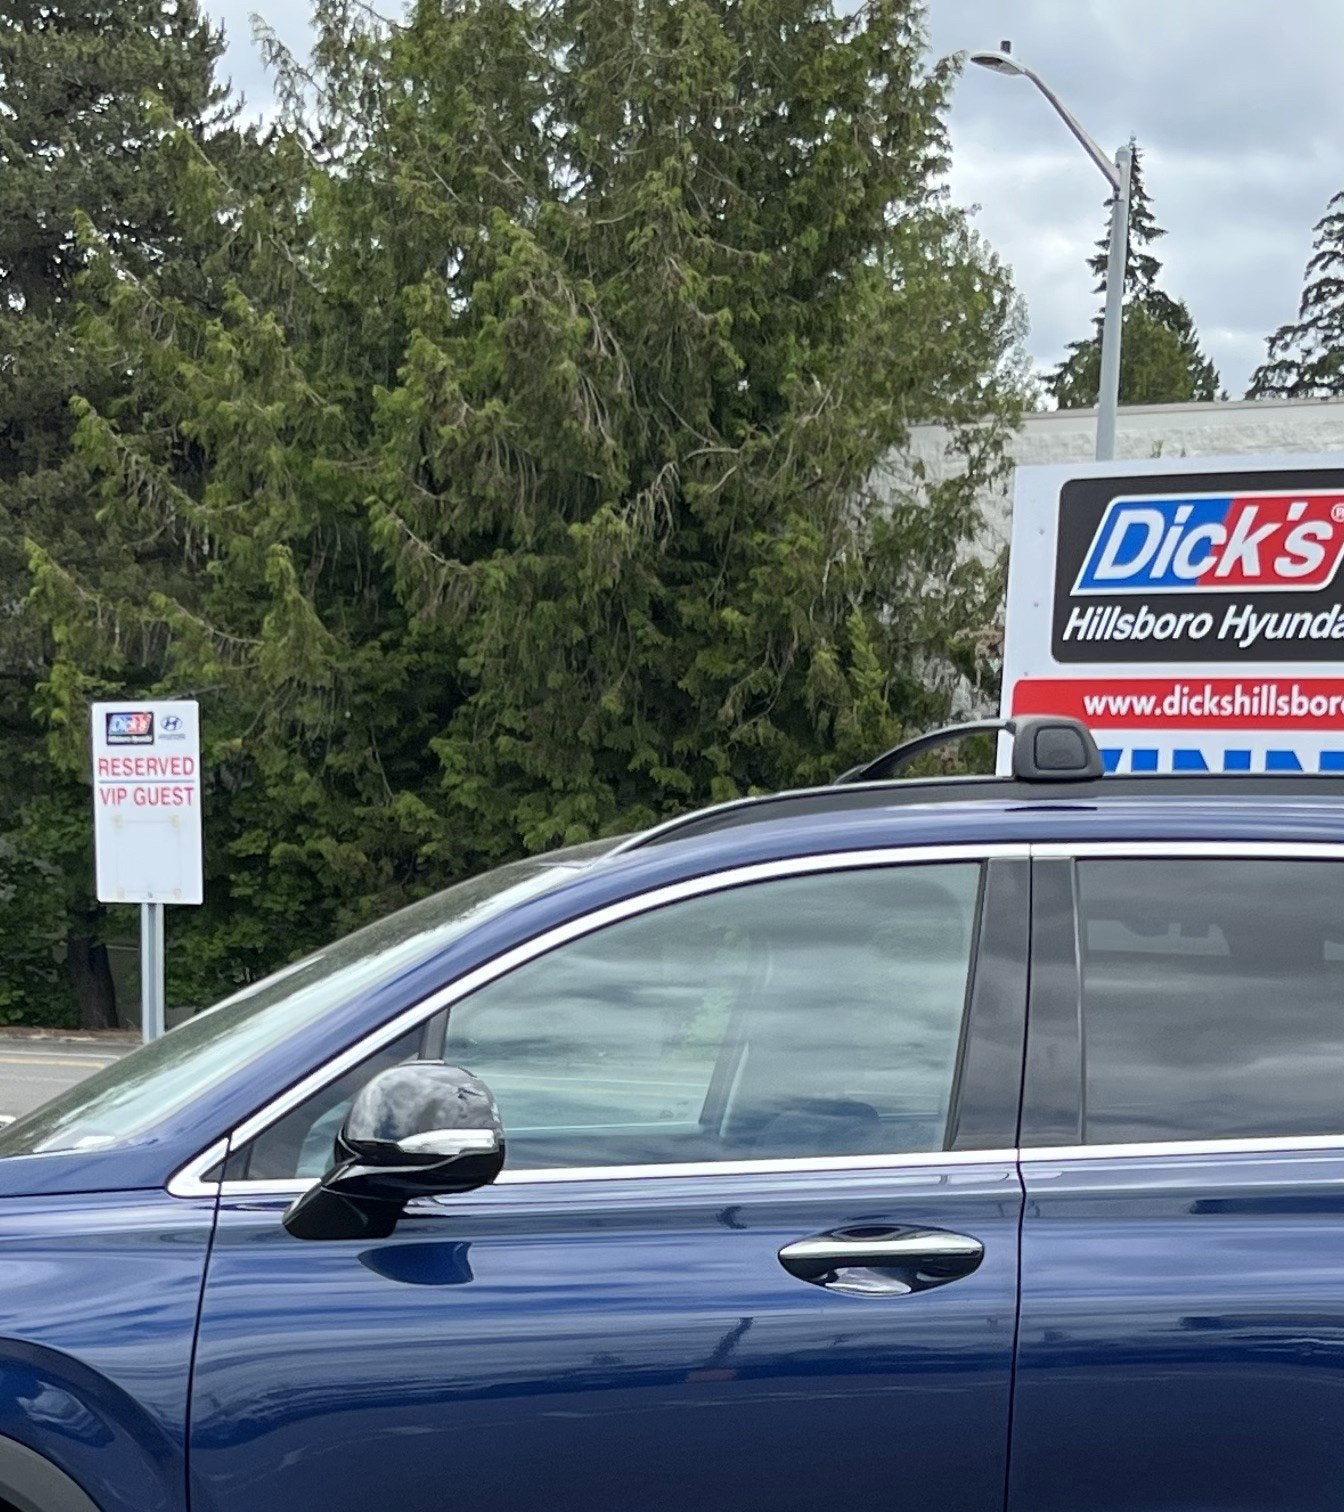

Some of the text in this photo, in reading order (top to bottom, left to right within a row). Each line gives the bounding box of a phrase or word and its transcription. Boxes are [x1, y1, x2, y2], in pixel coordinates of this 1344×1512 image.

[1062, 605, 1214, 641] Hillsboro
[98, 757, 195, 776] RESERVED
[99, 786, 195, 806] VIP GUEST
